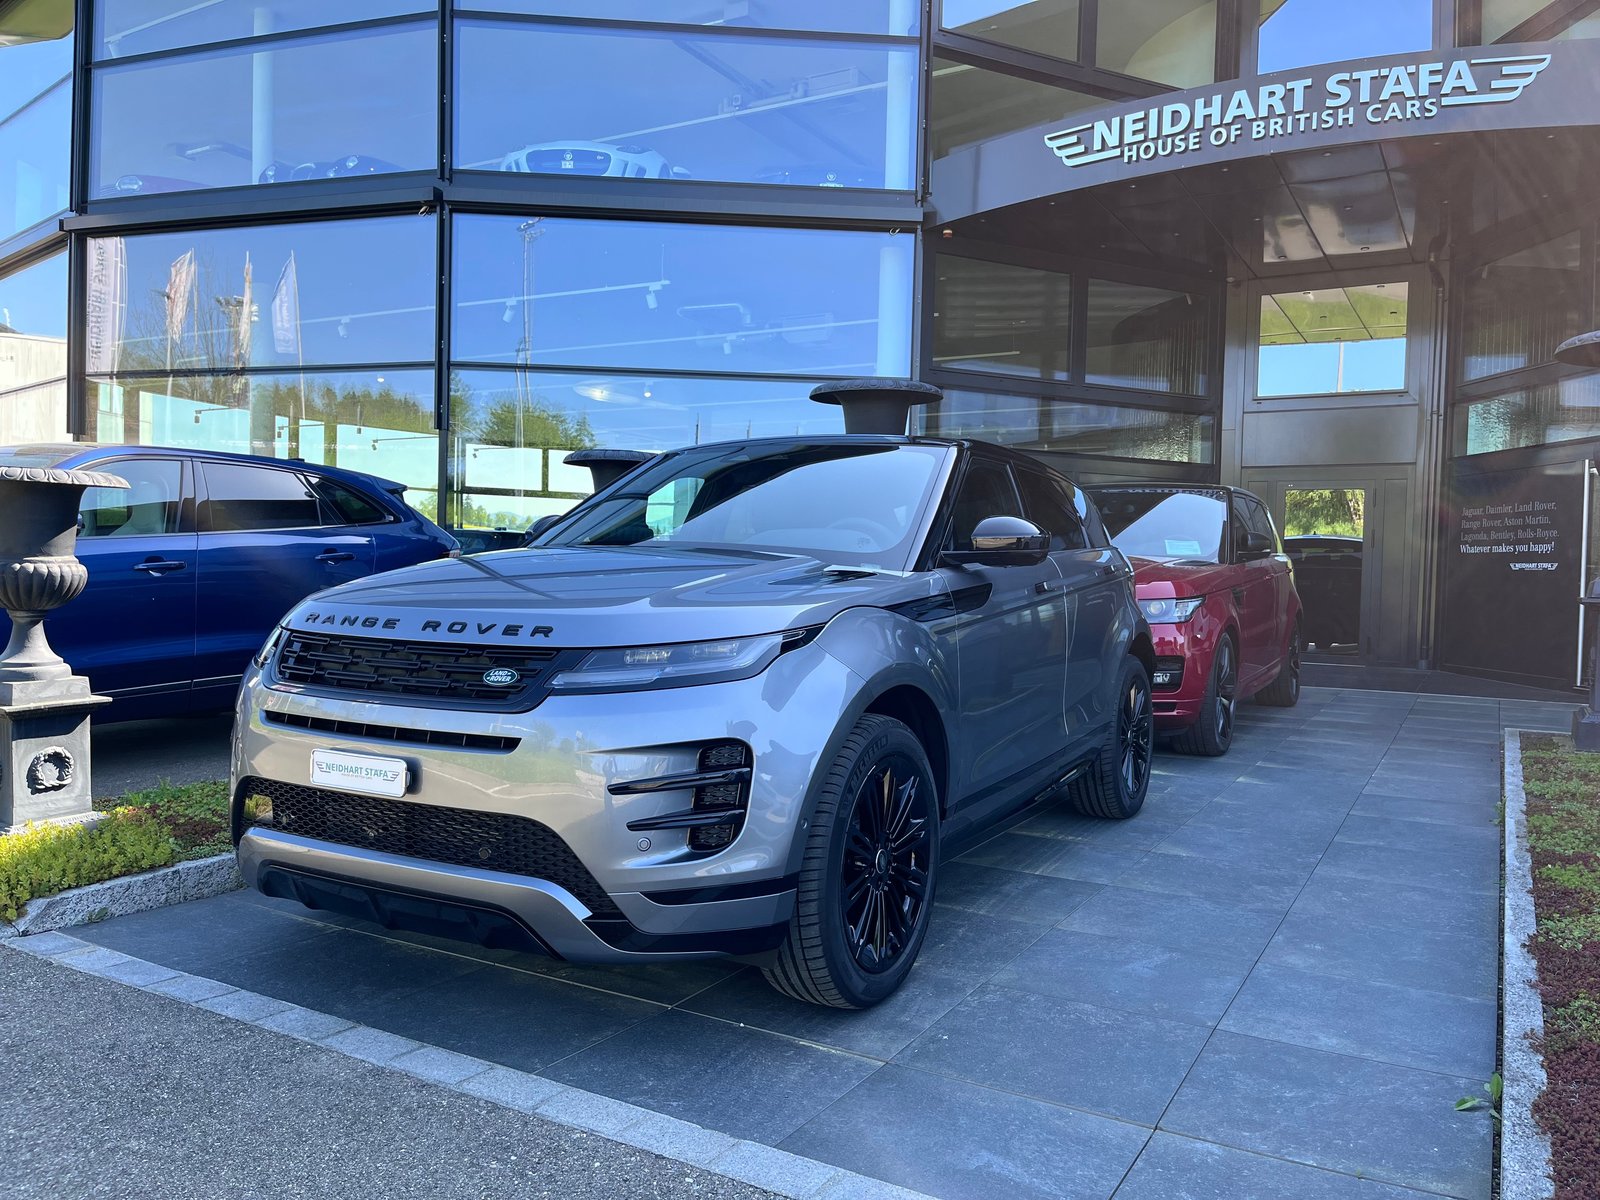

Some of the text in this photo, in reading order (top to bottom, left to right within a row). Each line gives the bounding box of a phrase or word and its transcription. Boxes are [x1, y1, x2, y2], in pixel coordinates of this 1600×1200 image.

[1092, 59, 1478, 151] NEIDHART STÄFA
[1122, 97, 1439, 163] HOUSE OF BRITISH CARS
[1515, 502, 1532, 512] Land
[1534, 501, 1557, 510] Rover,
[1461, 515, 1551, 530] Range Rover, Aston Martin,
[1460, 531, 1489, 543] Lagonda,
[1490, 530, 1516, 542] Bentley,
[1460, 541, 1555, 555] Whatever makes you happy!
[304, 612, 555, 638] RANGE ROVER
[325, 763, 363, 774] NEIDHART
[365, 768, 389, 778] STÄFA
